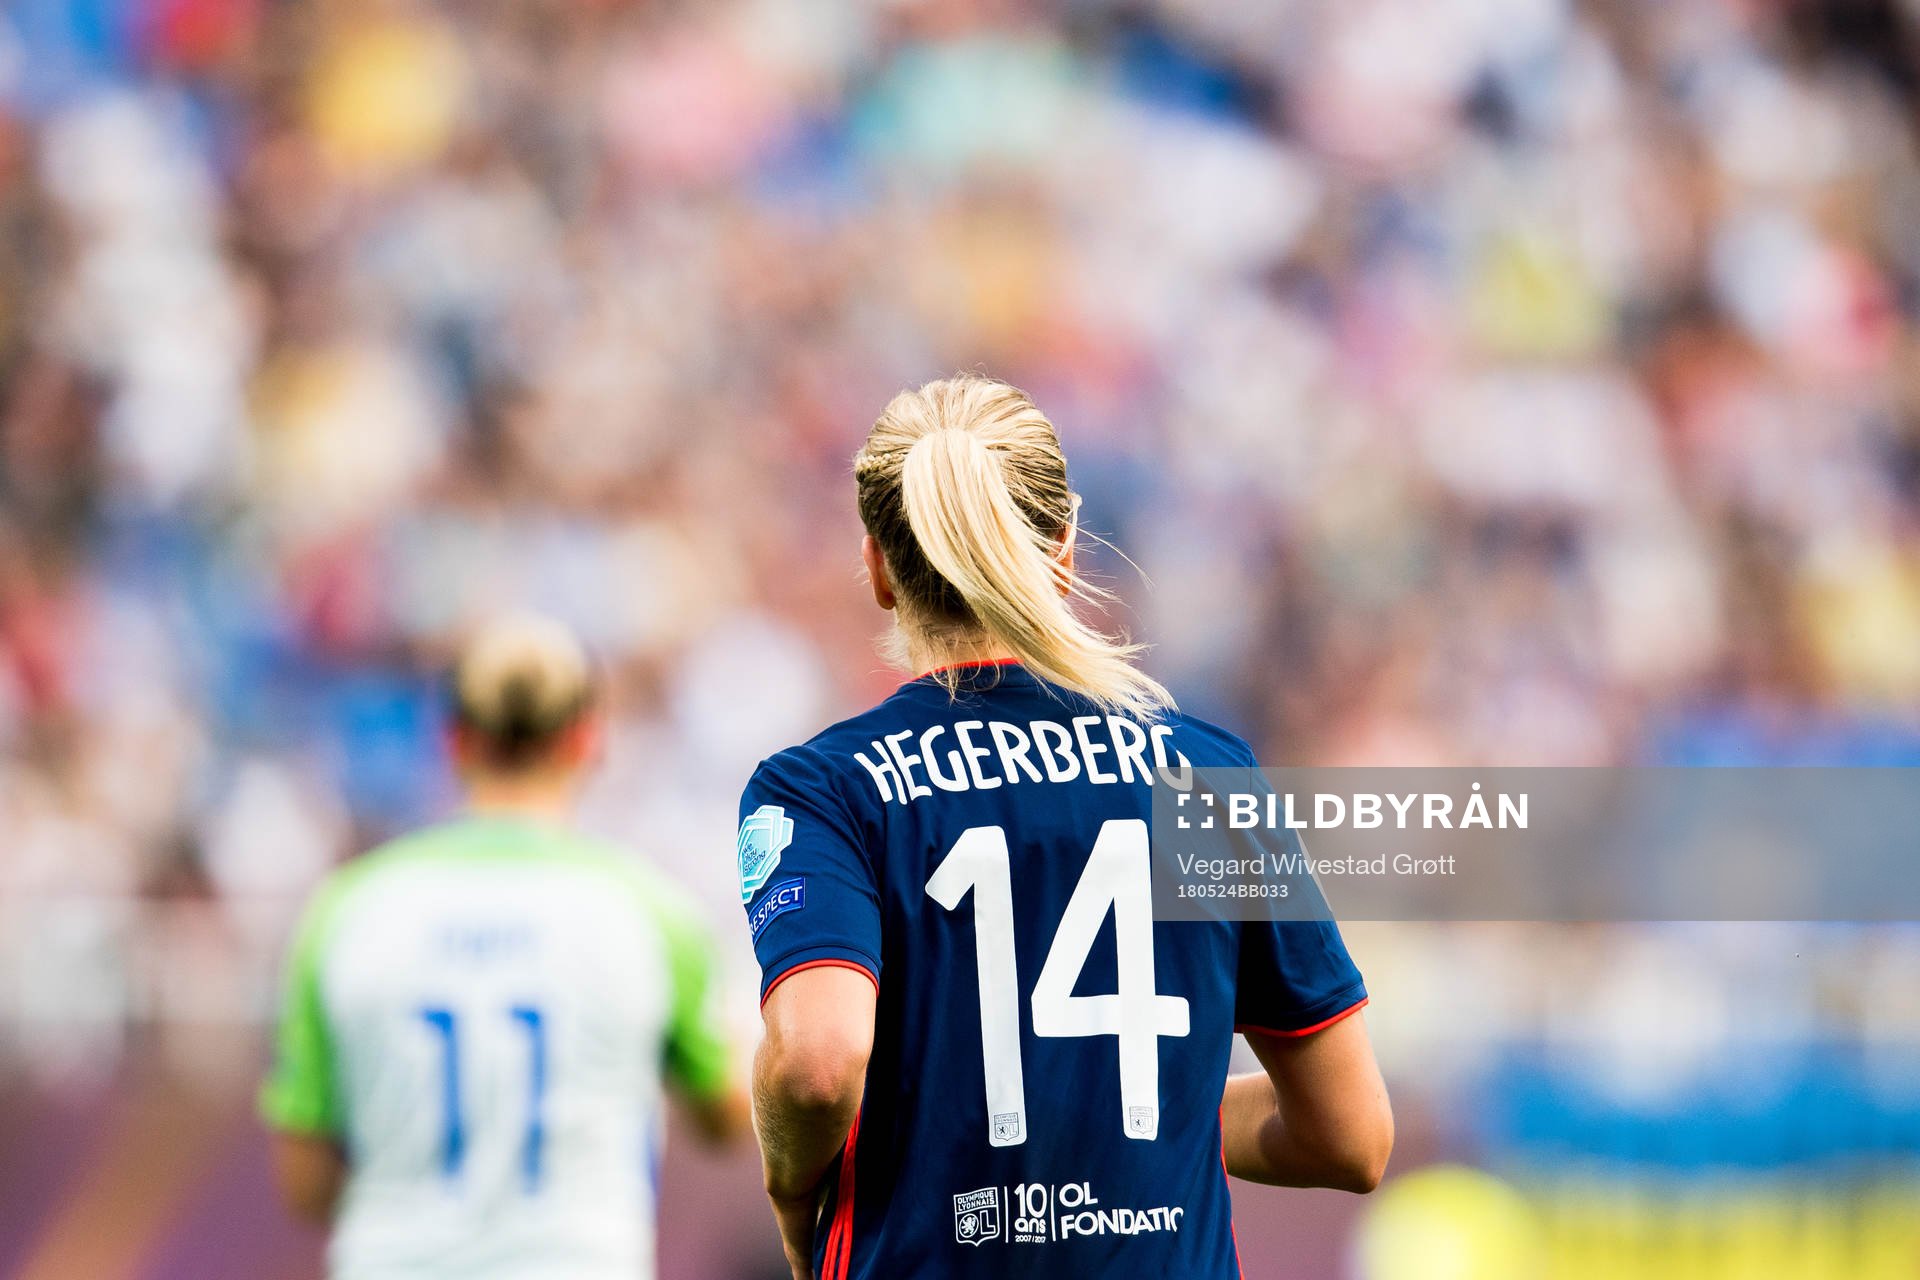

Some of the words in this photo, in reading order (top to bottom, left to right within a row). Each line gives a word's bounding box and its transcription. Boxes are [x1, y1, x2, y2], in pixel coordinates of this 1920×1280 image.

[854, 715, 1194, 805] HEGERBERG
[925, 819, 1190, 1147] 14
[420, 1002, 545, 1196] 11
[957, 1190, 994, 1204] OLYMPIQUE
[958, 1198, 995, 1211] LYONNAIS
[1014, 1183, 1047, 1218] 10
[1059, 1182, 1098, 1207] OL
[1014, 1217, 1046, 1234] ans
